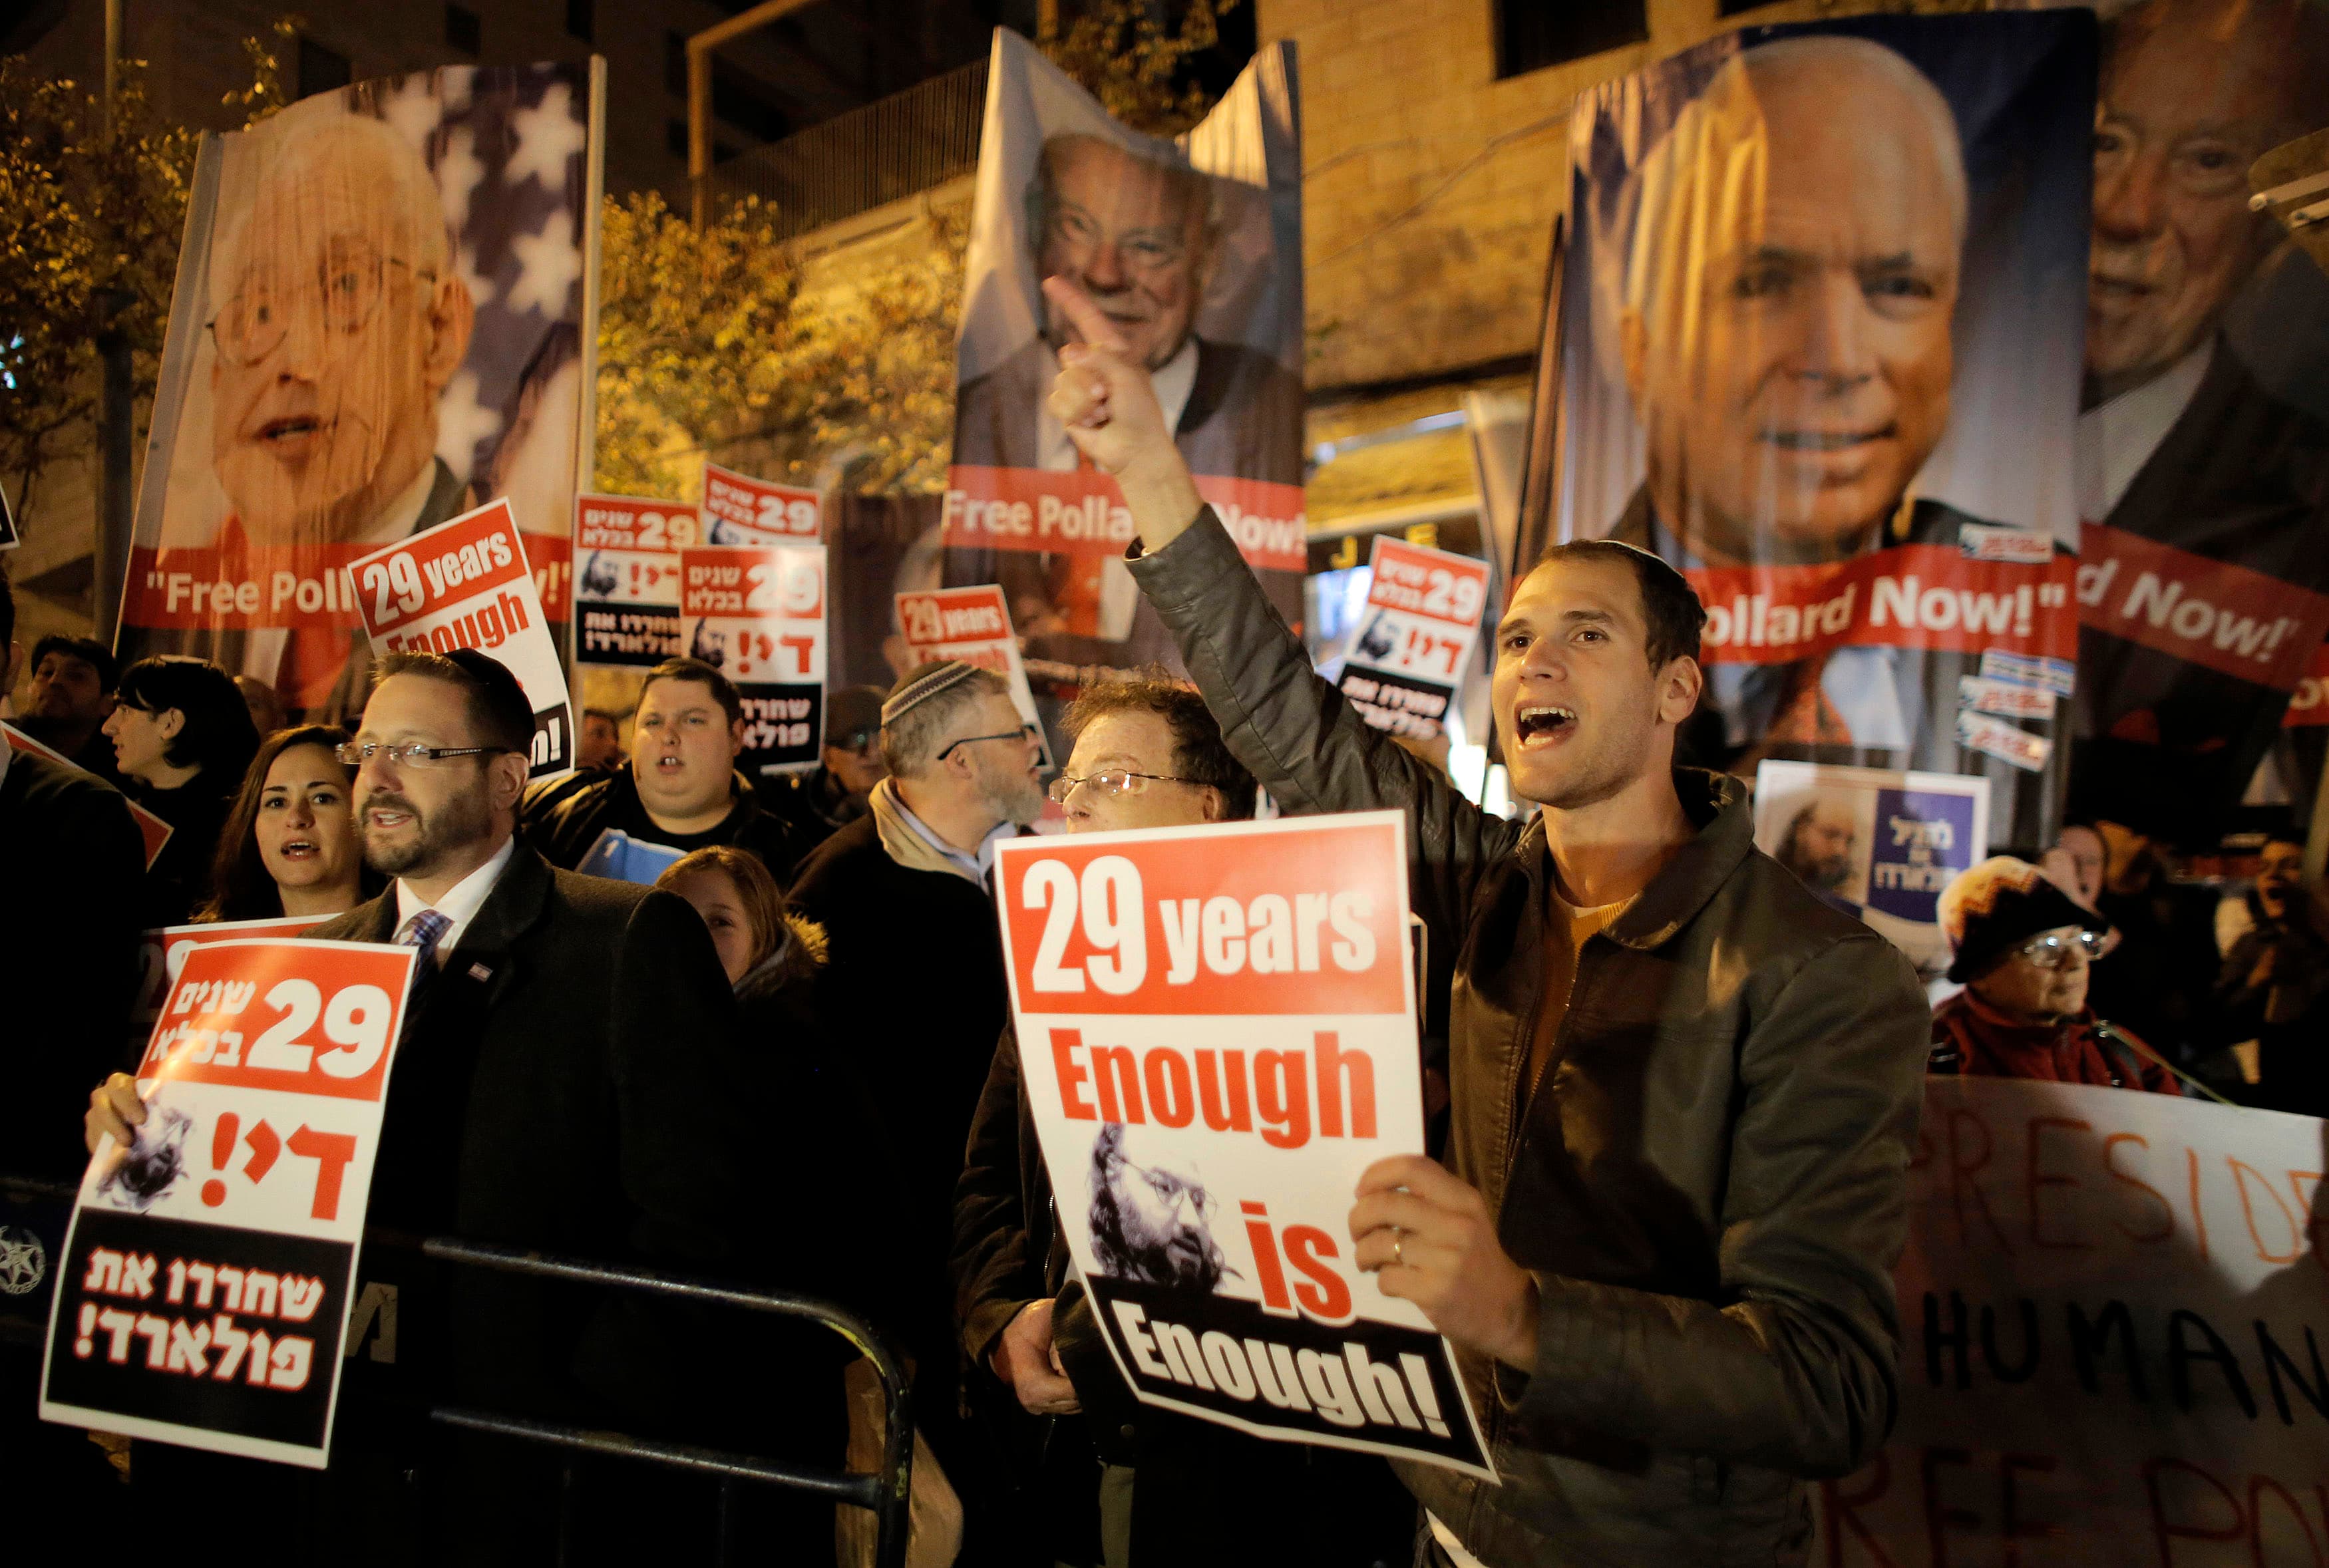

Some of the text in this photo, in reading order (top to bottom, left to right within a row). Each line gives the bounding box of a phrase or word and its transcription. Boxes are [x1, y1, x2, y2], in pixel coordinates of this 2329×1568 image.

[637, 511, 697, 548] 29
[755, 494, 816, 533] 29
[941, 489, 1031, 536] Free
[1038, 494, 1133, 542] Polla
[147, 566, 363, 614] "Free Poll
[363, 551, 425, 627] 29
[423, 532, 512, 600] years
[687, 563, 821, 613] 29 שנים
[687, 587, 744, 612] בכלא
[1423, 567, 1481, 621] 29
[1700, 575, 2067, 647] ollard Now!"
[737, 629, 814, 674] די!
[1400, 627, 1462, 675] די!
[739, 698, 812, 720] שחרר
[741, 720, 810, 750] פולא
[1022, 854, 1378, 996] 29 years
[149, 1021, 244, 1068] בכלא
[172, 978, 392, 1080] 29 שנים
[1048, 1027, 1379, 1150] Enough
[200, 1112, 358, 1222] די!
[85, 1248, 324, 1323] שחררו את
[1238, 1199, 1353, 1320] is
[75, 1303, 314, 1390] פולארד!
[1110, 1299, 1452, 1440] Enough!
